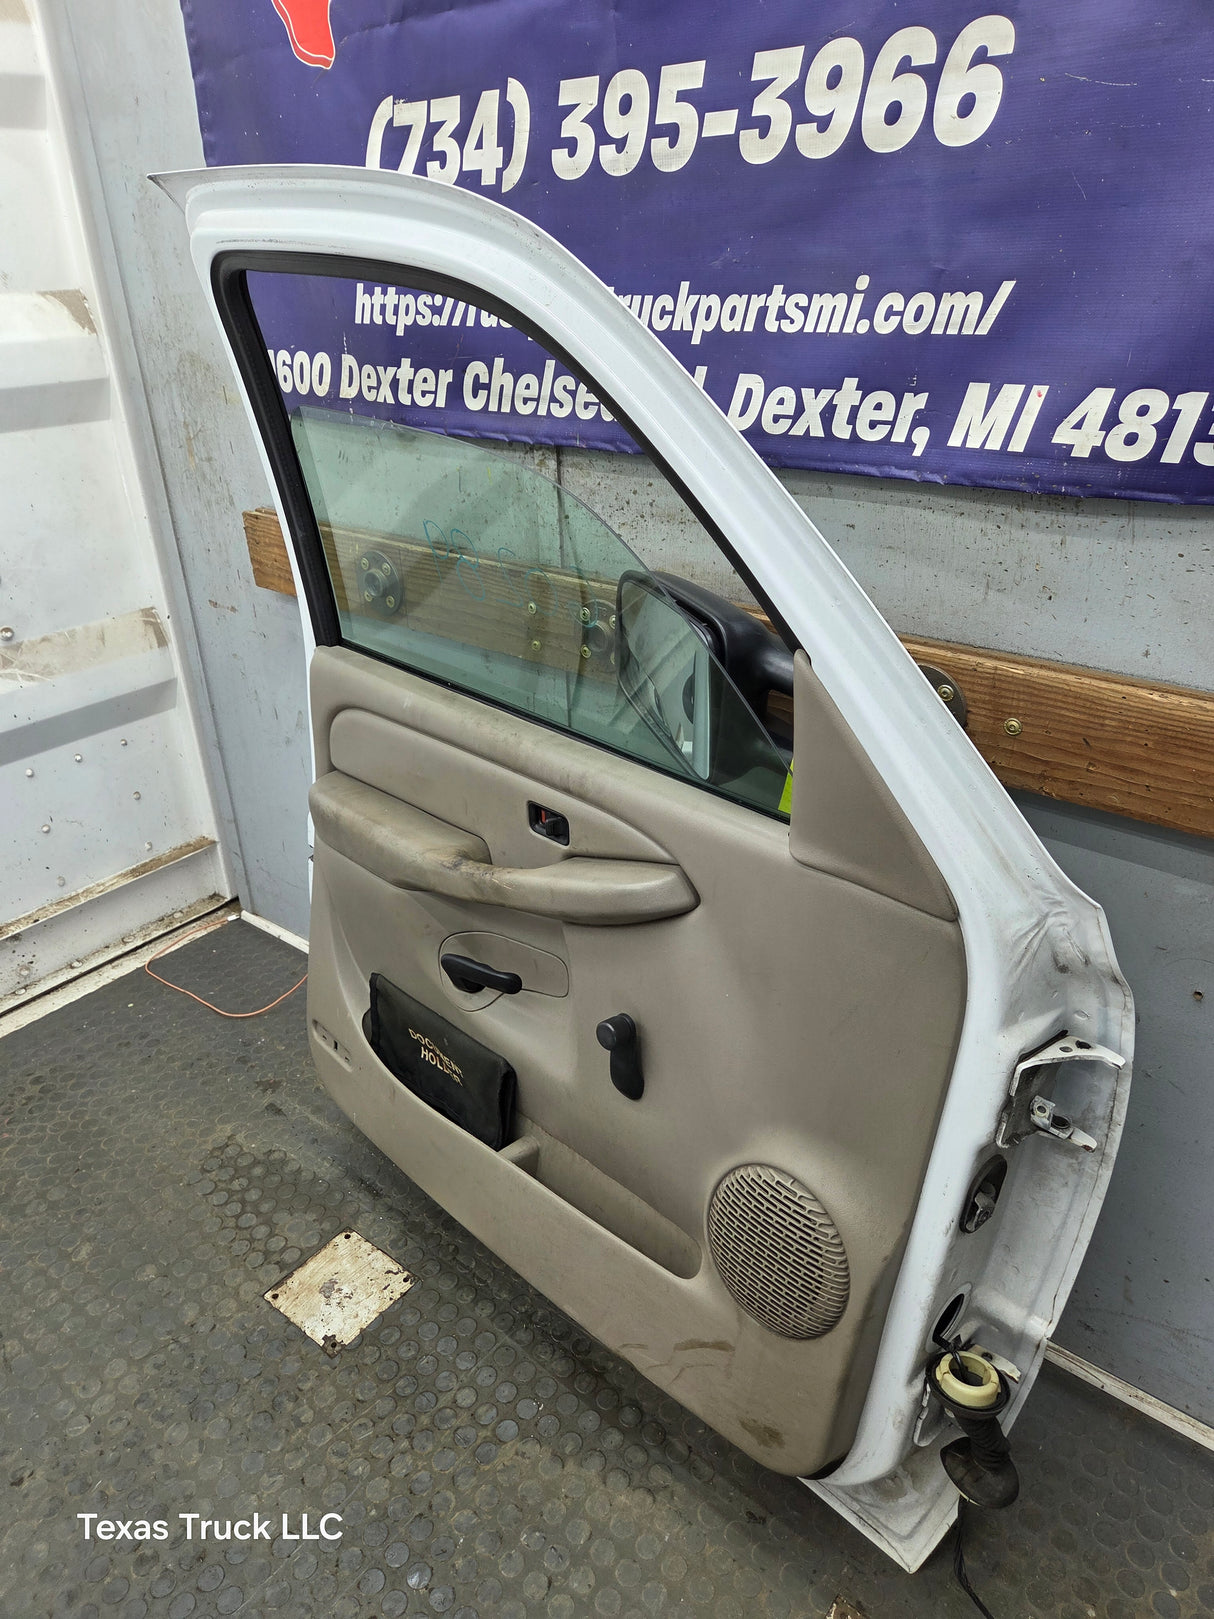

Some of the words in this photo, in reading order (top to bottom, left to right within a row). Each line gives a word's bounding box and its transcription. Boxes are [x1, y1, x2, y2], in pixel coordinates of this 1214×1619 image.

[365, 77, 531, 193] (734)
[551, 15, 1016, 182] 395-3966
[339, 353, 453, 408] Dexter
[727, 373, 929, 457] Dexter,
[947, 382, 1049, 453] MI
